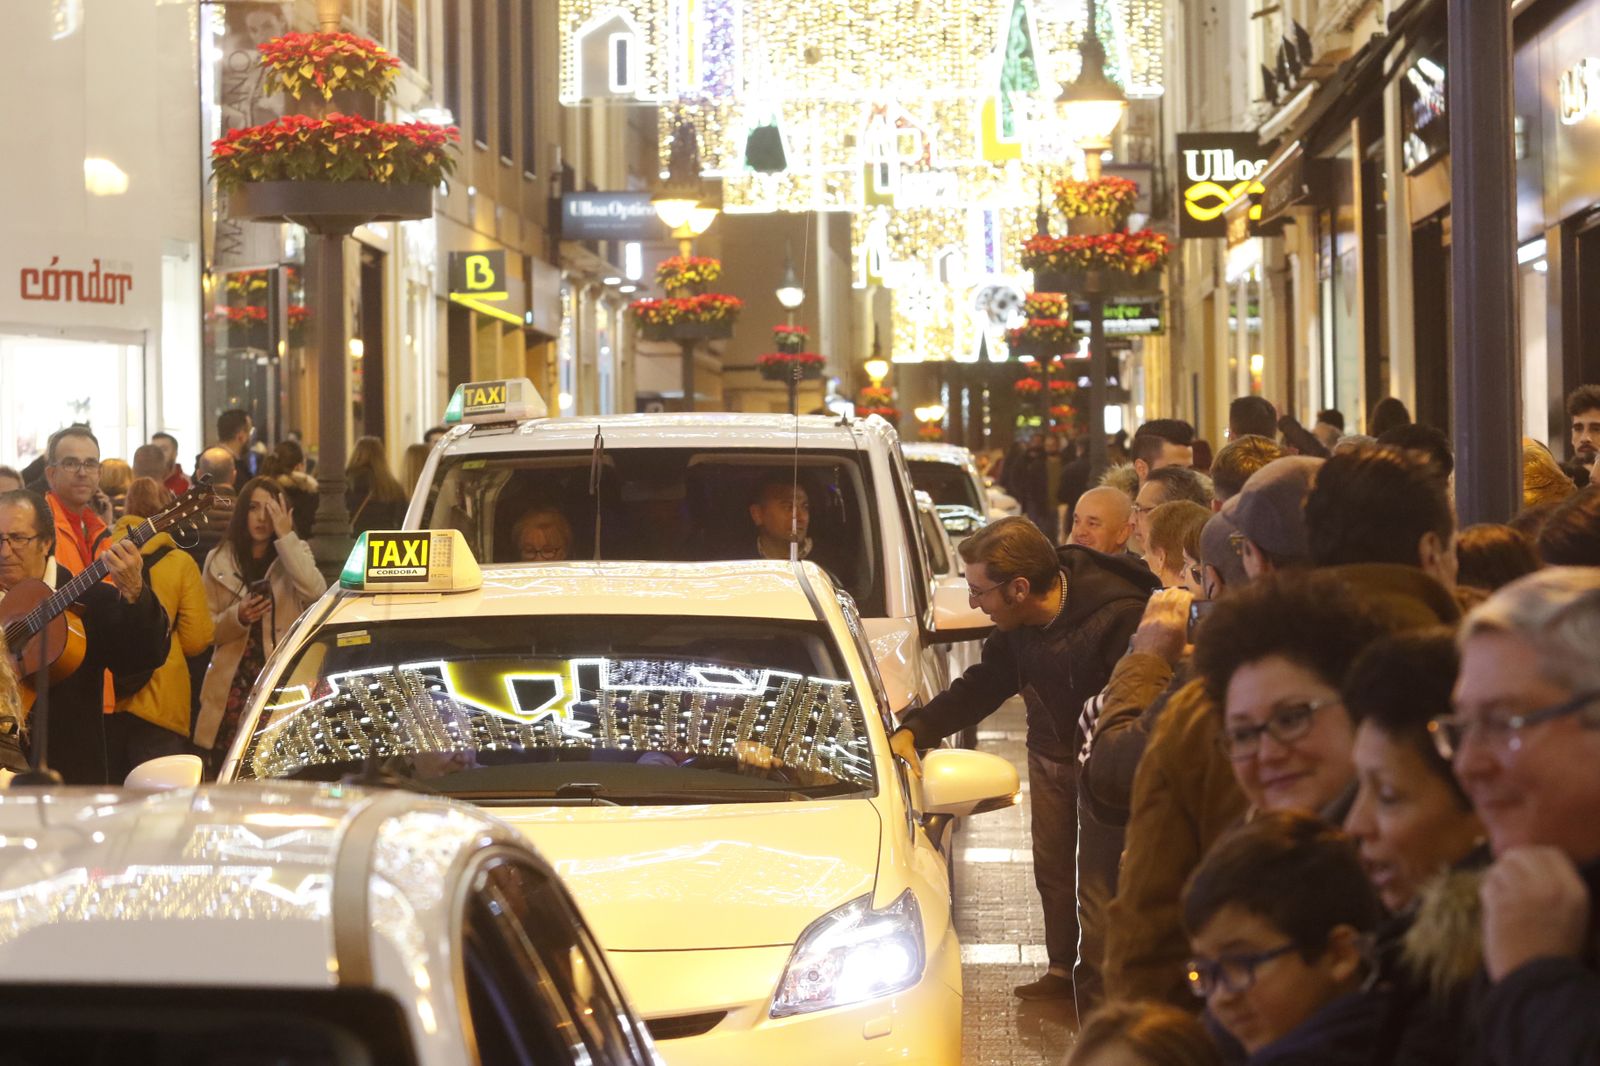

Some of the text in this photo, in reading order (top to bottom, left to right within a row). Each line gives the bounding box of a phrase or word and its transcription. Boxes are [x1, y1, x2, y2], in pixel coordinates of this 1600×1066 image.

[20, 256, 132, 305] cóndor
[465, 254, 496, 290] B
[464, 386, 506, 407] TAXI
[369, 539, 429, 567] TAXI
